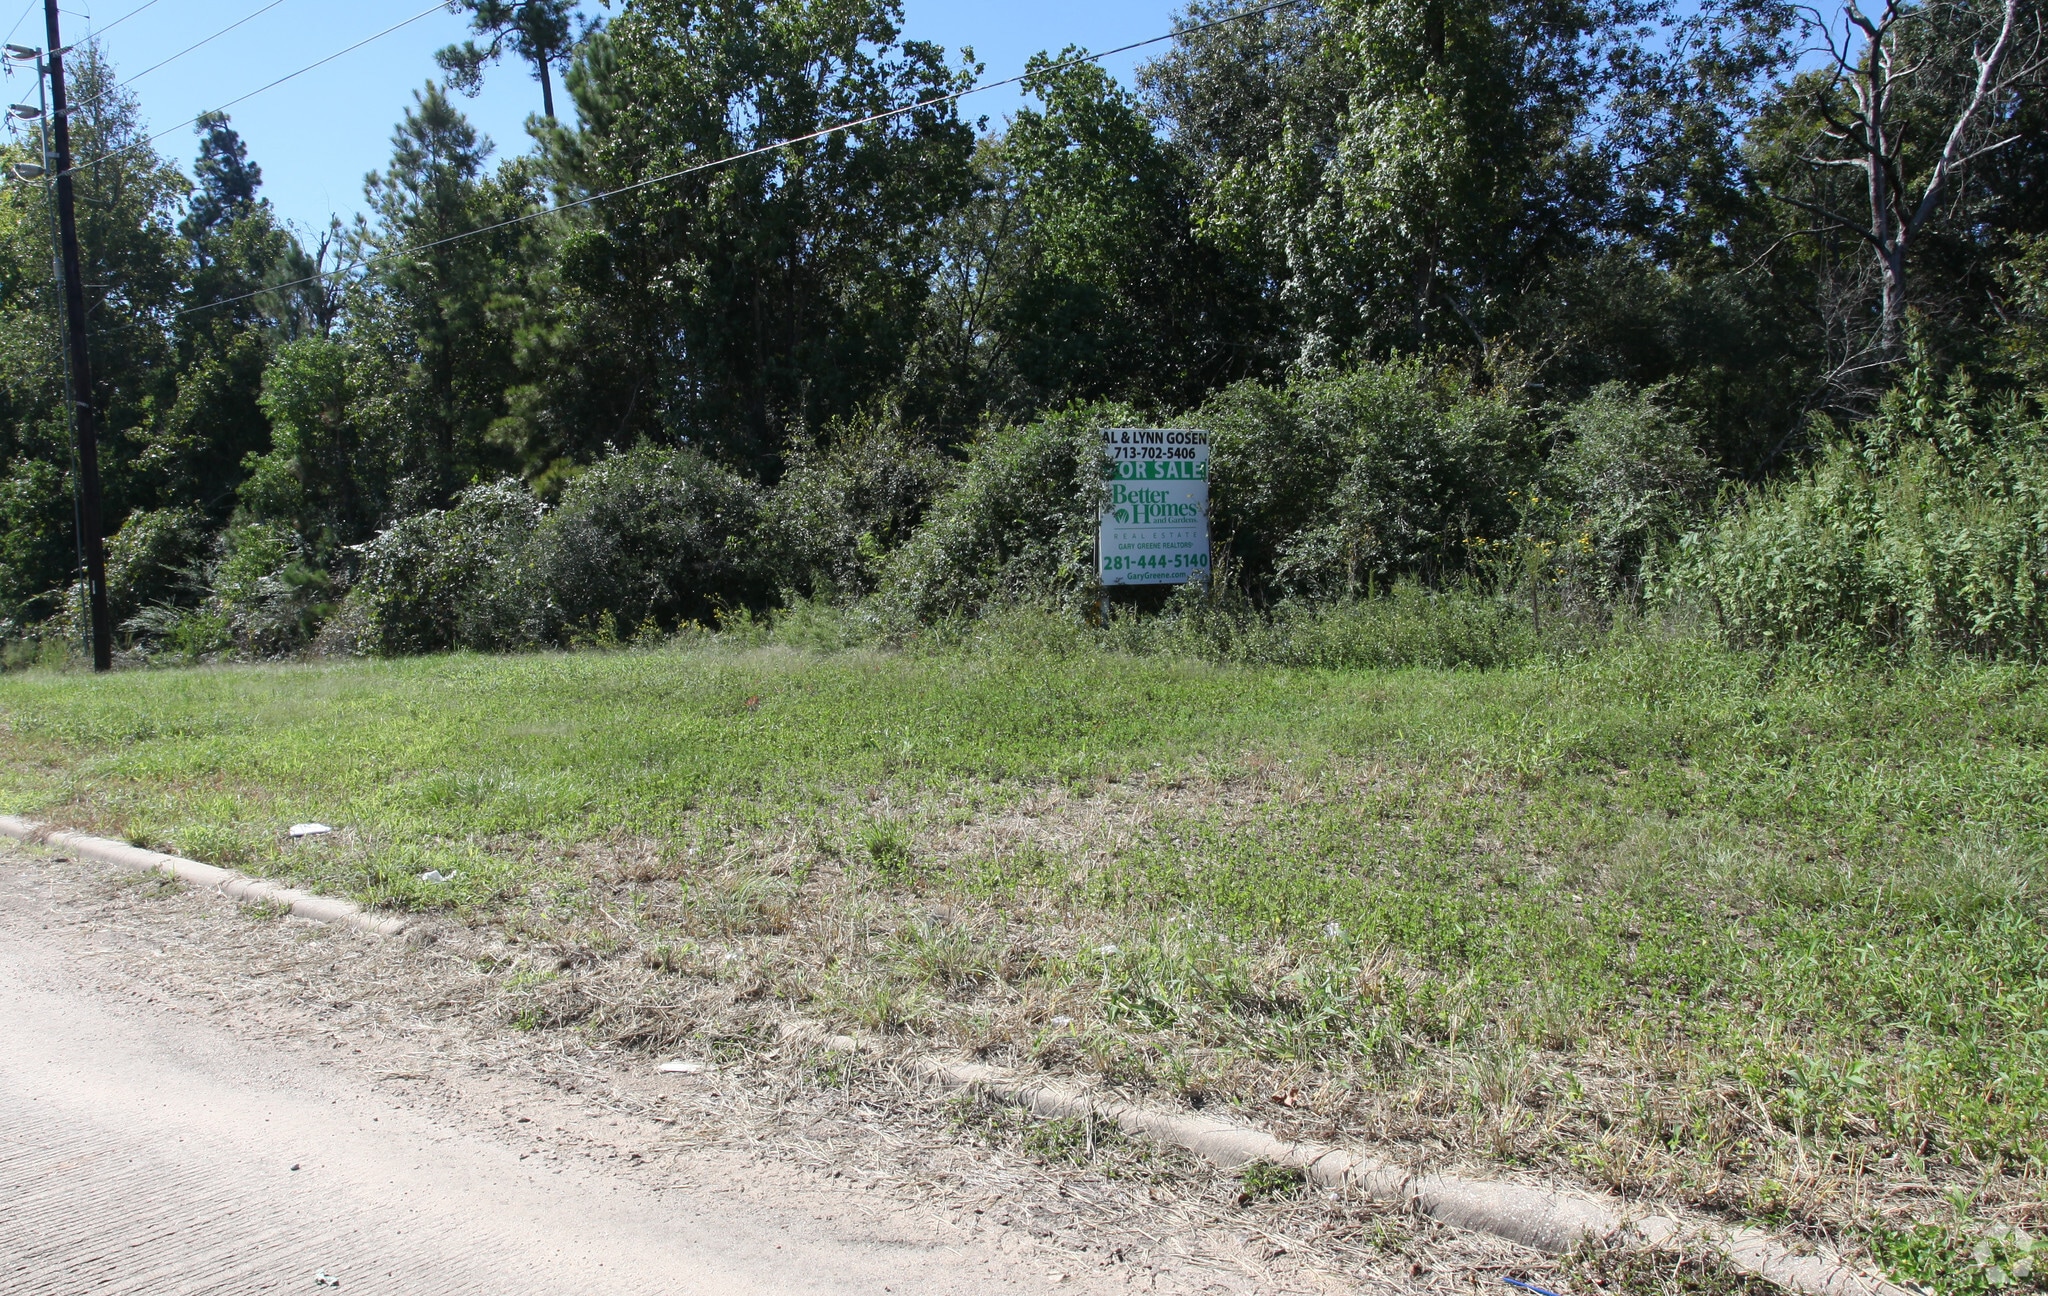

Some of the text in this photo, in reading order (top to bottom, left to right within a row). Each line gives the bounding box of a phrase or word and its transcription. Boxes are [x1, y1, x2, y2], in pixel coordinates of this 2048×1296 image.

[1102, 431, 1207, 445] AL & LYNN GOSEN
[1114, 447, 1196, 459] 713-702-5406
[1110, 461, 1201, 479] OR SALE
[1112, 483, 1169, 504] Better
[1132, 503, 1197, 524] Homes
[1153, 531, 1198, 539] ESTATE
[1137, 542, 1161, 550] GREENE
[1103, 553, 1208, 570] 281-444-5140
[1127, 571, 1187, 580] GaryGreene.com
